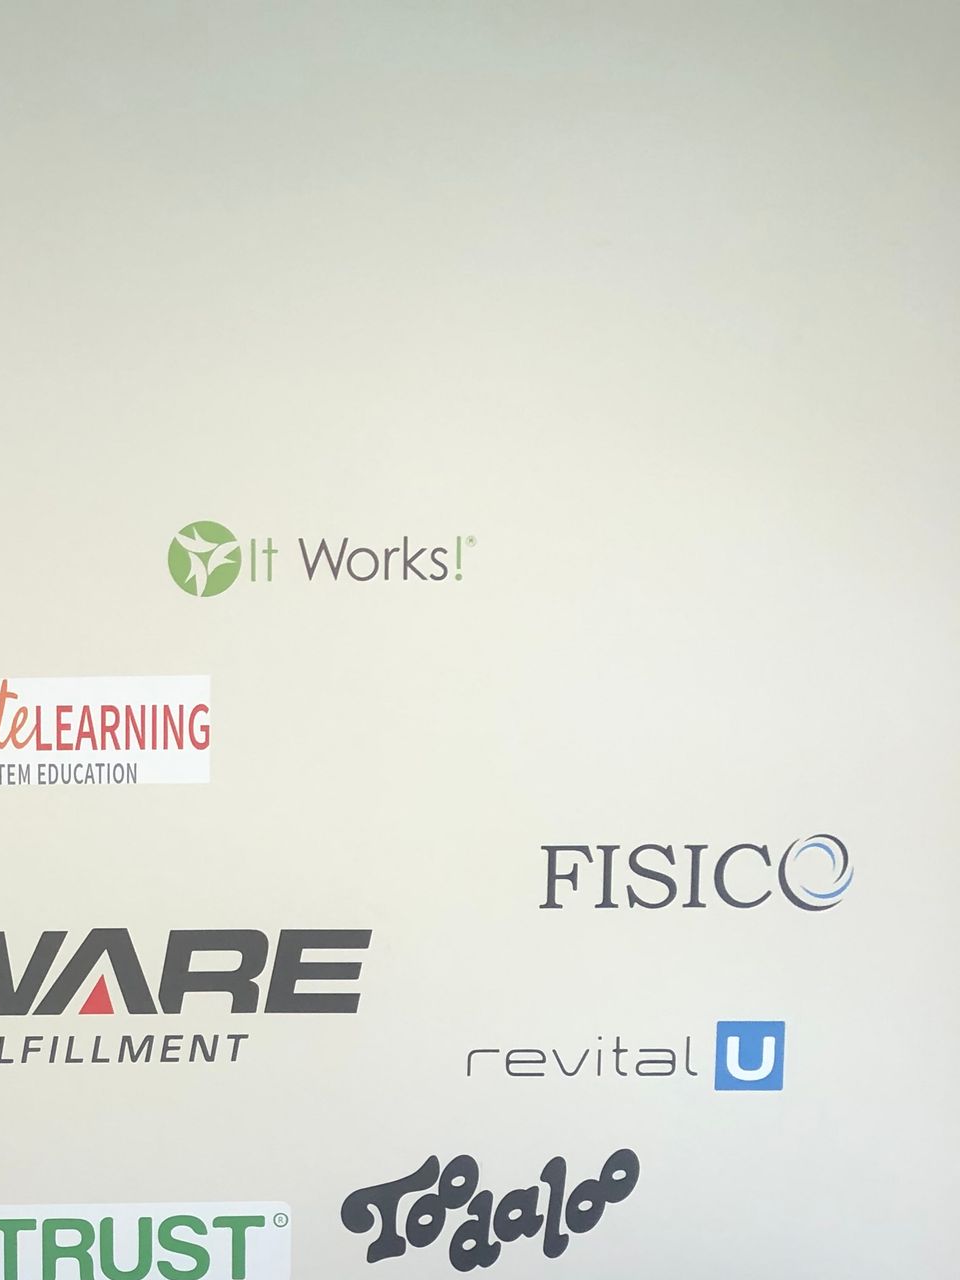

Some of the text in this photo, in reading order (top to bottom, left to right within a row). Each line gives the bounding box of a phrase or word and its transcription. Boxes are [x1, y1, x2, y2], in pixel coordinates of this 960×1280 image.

[250, 537, 279, 582] It
[37, 762, 138, 785] EDUCATION
[538, 833, 854, 912] FISICO
[466, 1035, 698, 1077] revital
[340, 1148, 641, 1273] Toodaloo
